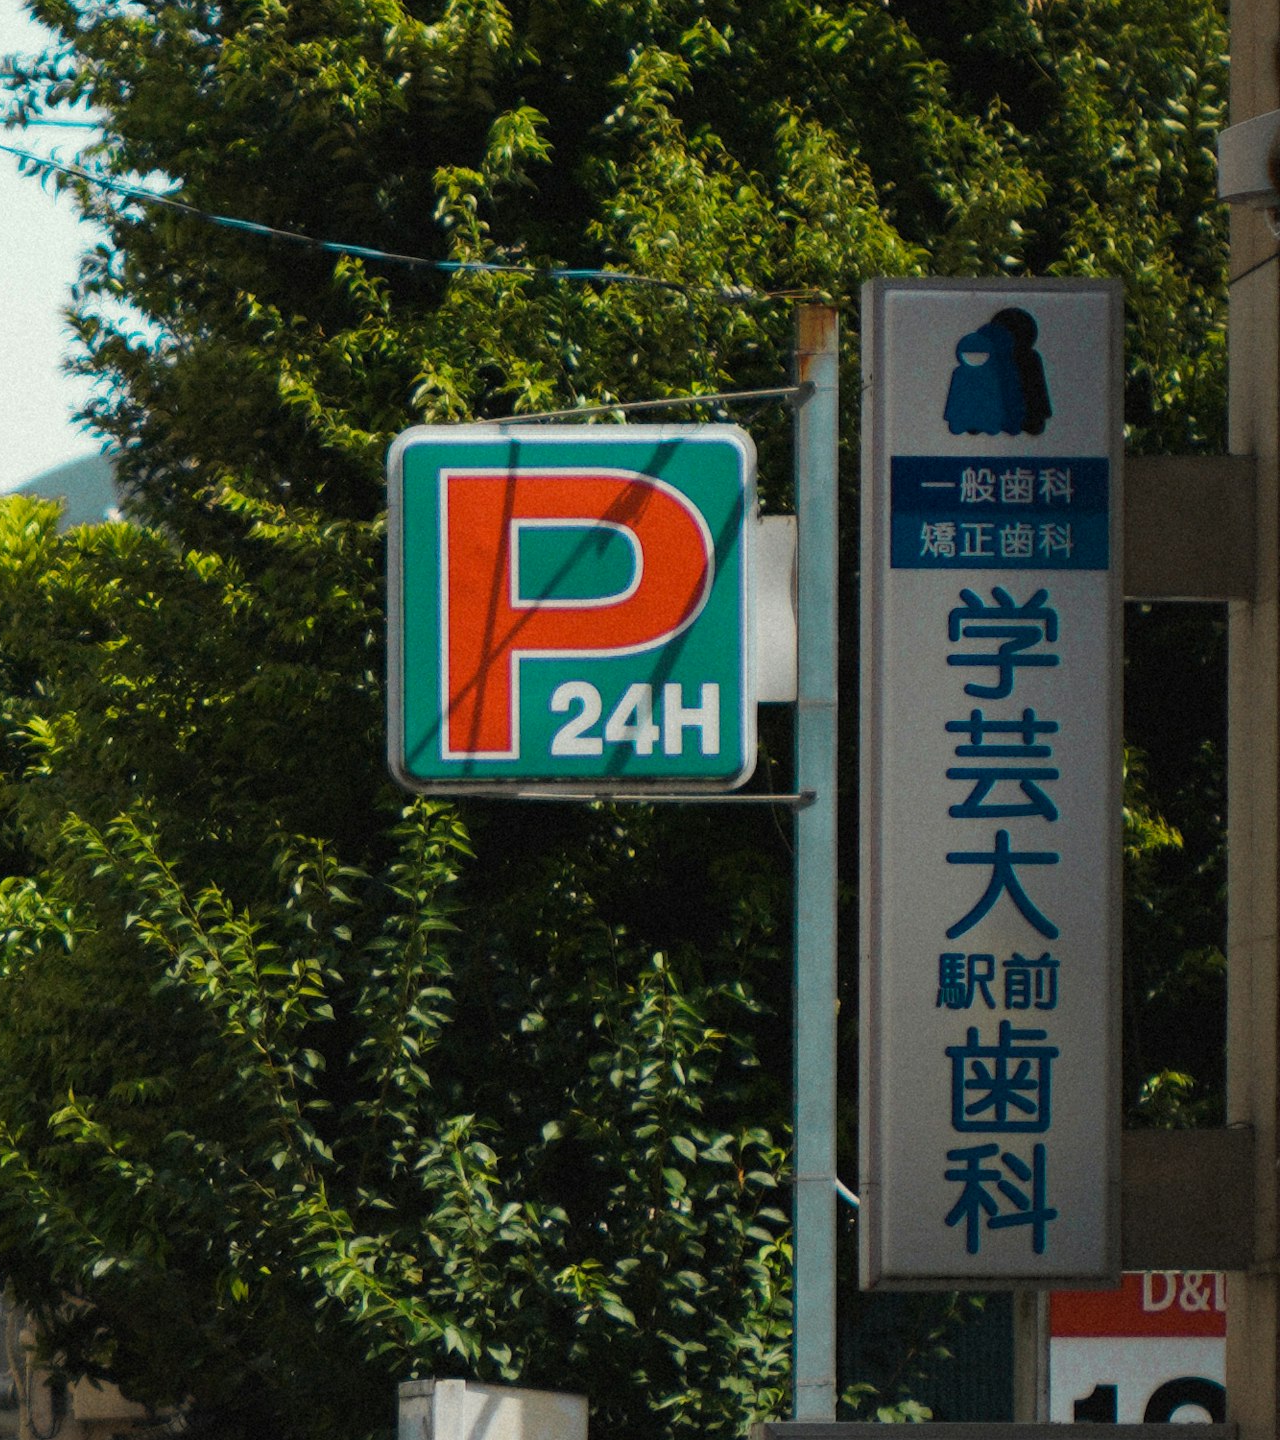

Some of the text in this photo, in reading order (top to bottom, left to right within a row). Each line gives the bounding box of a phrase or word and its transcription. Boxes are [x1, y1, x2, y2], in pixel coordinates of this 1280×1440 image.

[920, 467, 1075, 504] 一般歯科
[920, 521, 1075, 559] 矯正歯科
[440, 466, 715, 761] P
[549, 680, 721, 758] 24H
[935, 585, 1060, 1256] 学芸大駅前歯科
